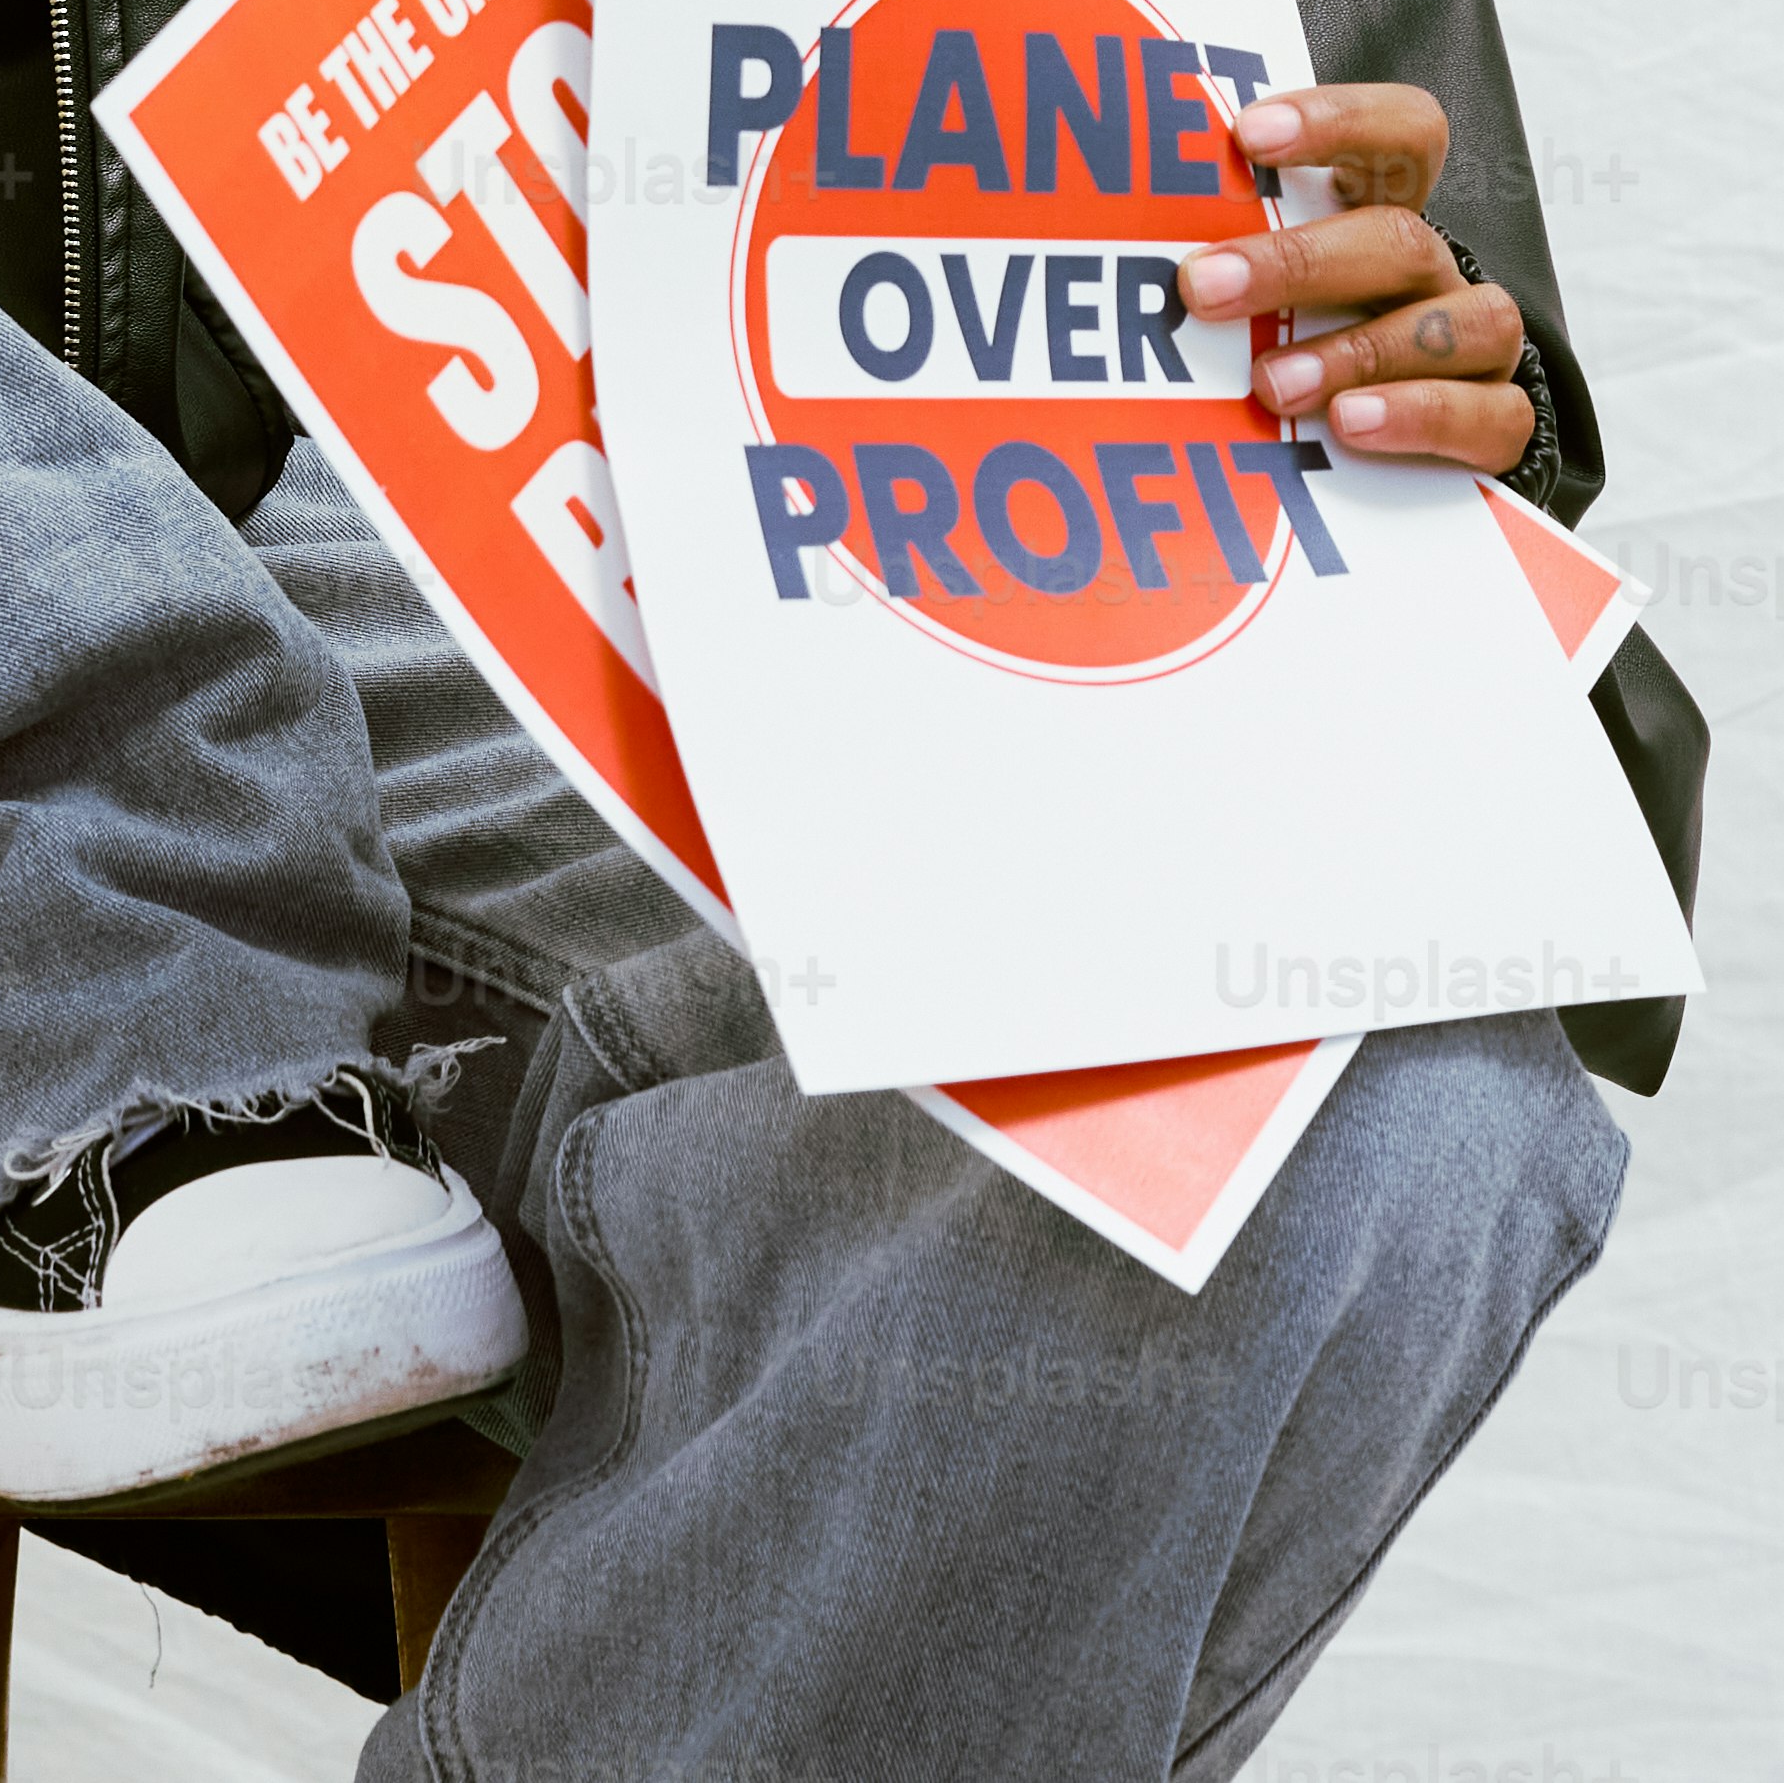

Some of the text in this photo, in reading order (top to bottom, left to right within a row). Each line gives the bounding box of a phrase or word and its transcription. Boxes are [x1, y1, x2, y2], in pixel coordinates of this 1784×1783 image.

[257, 82, 350, 203] BE
[706, 23, 1284, 199] PLANET
[838, 250, 1195, 383] OVER
[743, 439, 1350, 600] PROFIT
